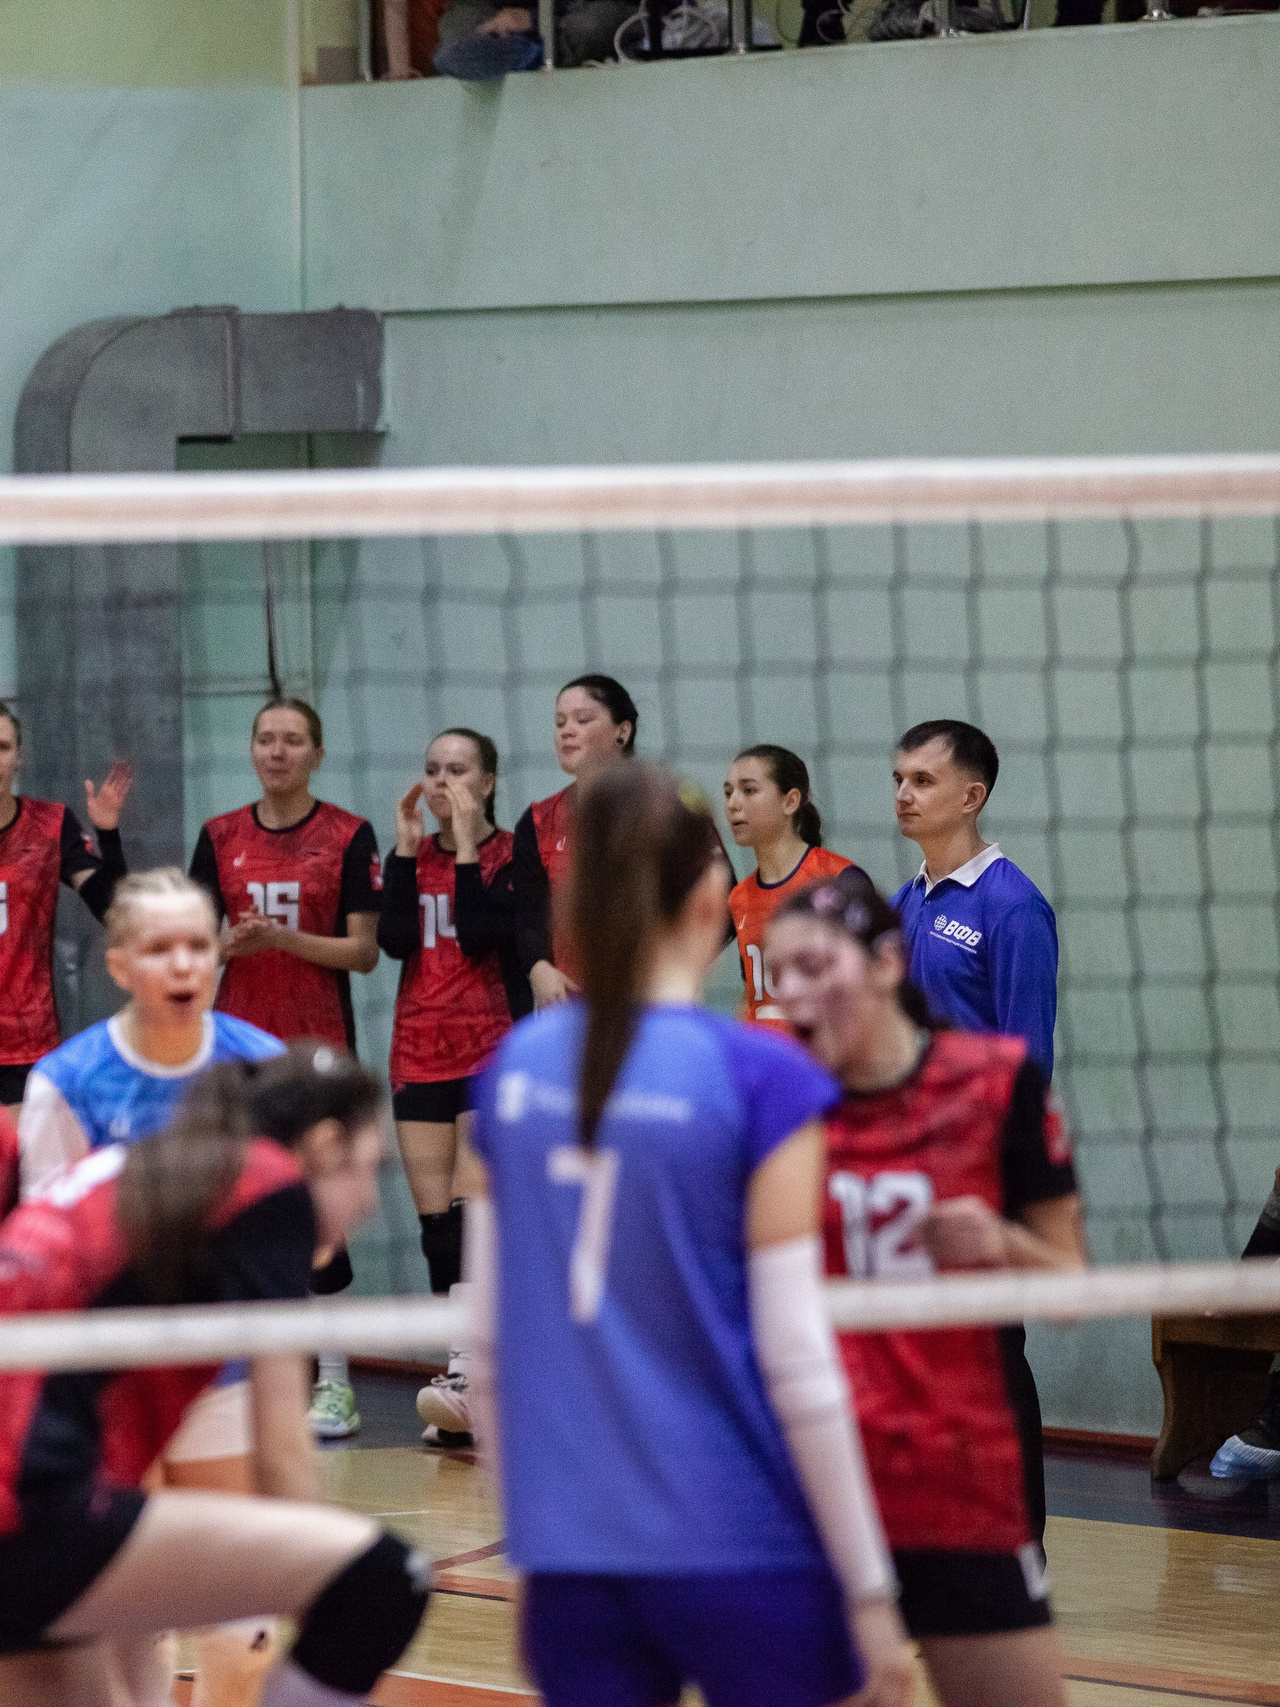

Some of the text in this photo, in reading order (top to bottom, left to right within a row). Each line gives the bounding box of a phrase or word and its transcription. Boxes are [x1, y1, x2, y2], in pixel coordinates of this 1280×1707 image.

[246, 881, 300, 932] 15
[943, 920, 982, 946] ВФВ
[547, 1146, 619, 1323] 7
[829, 1171, 933, 1283] 12
